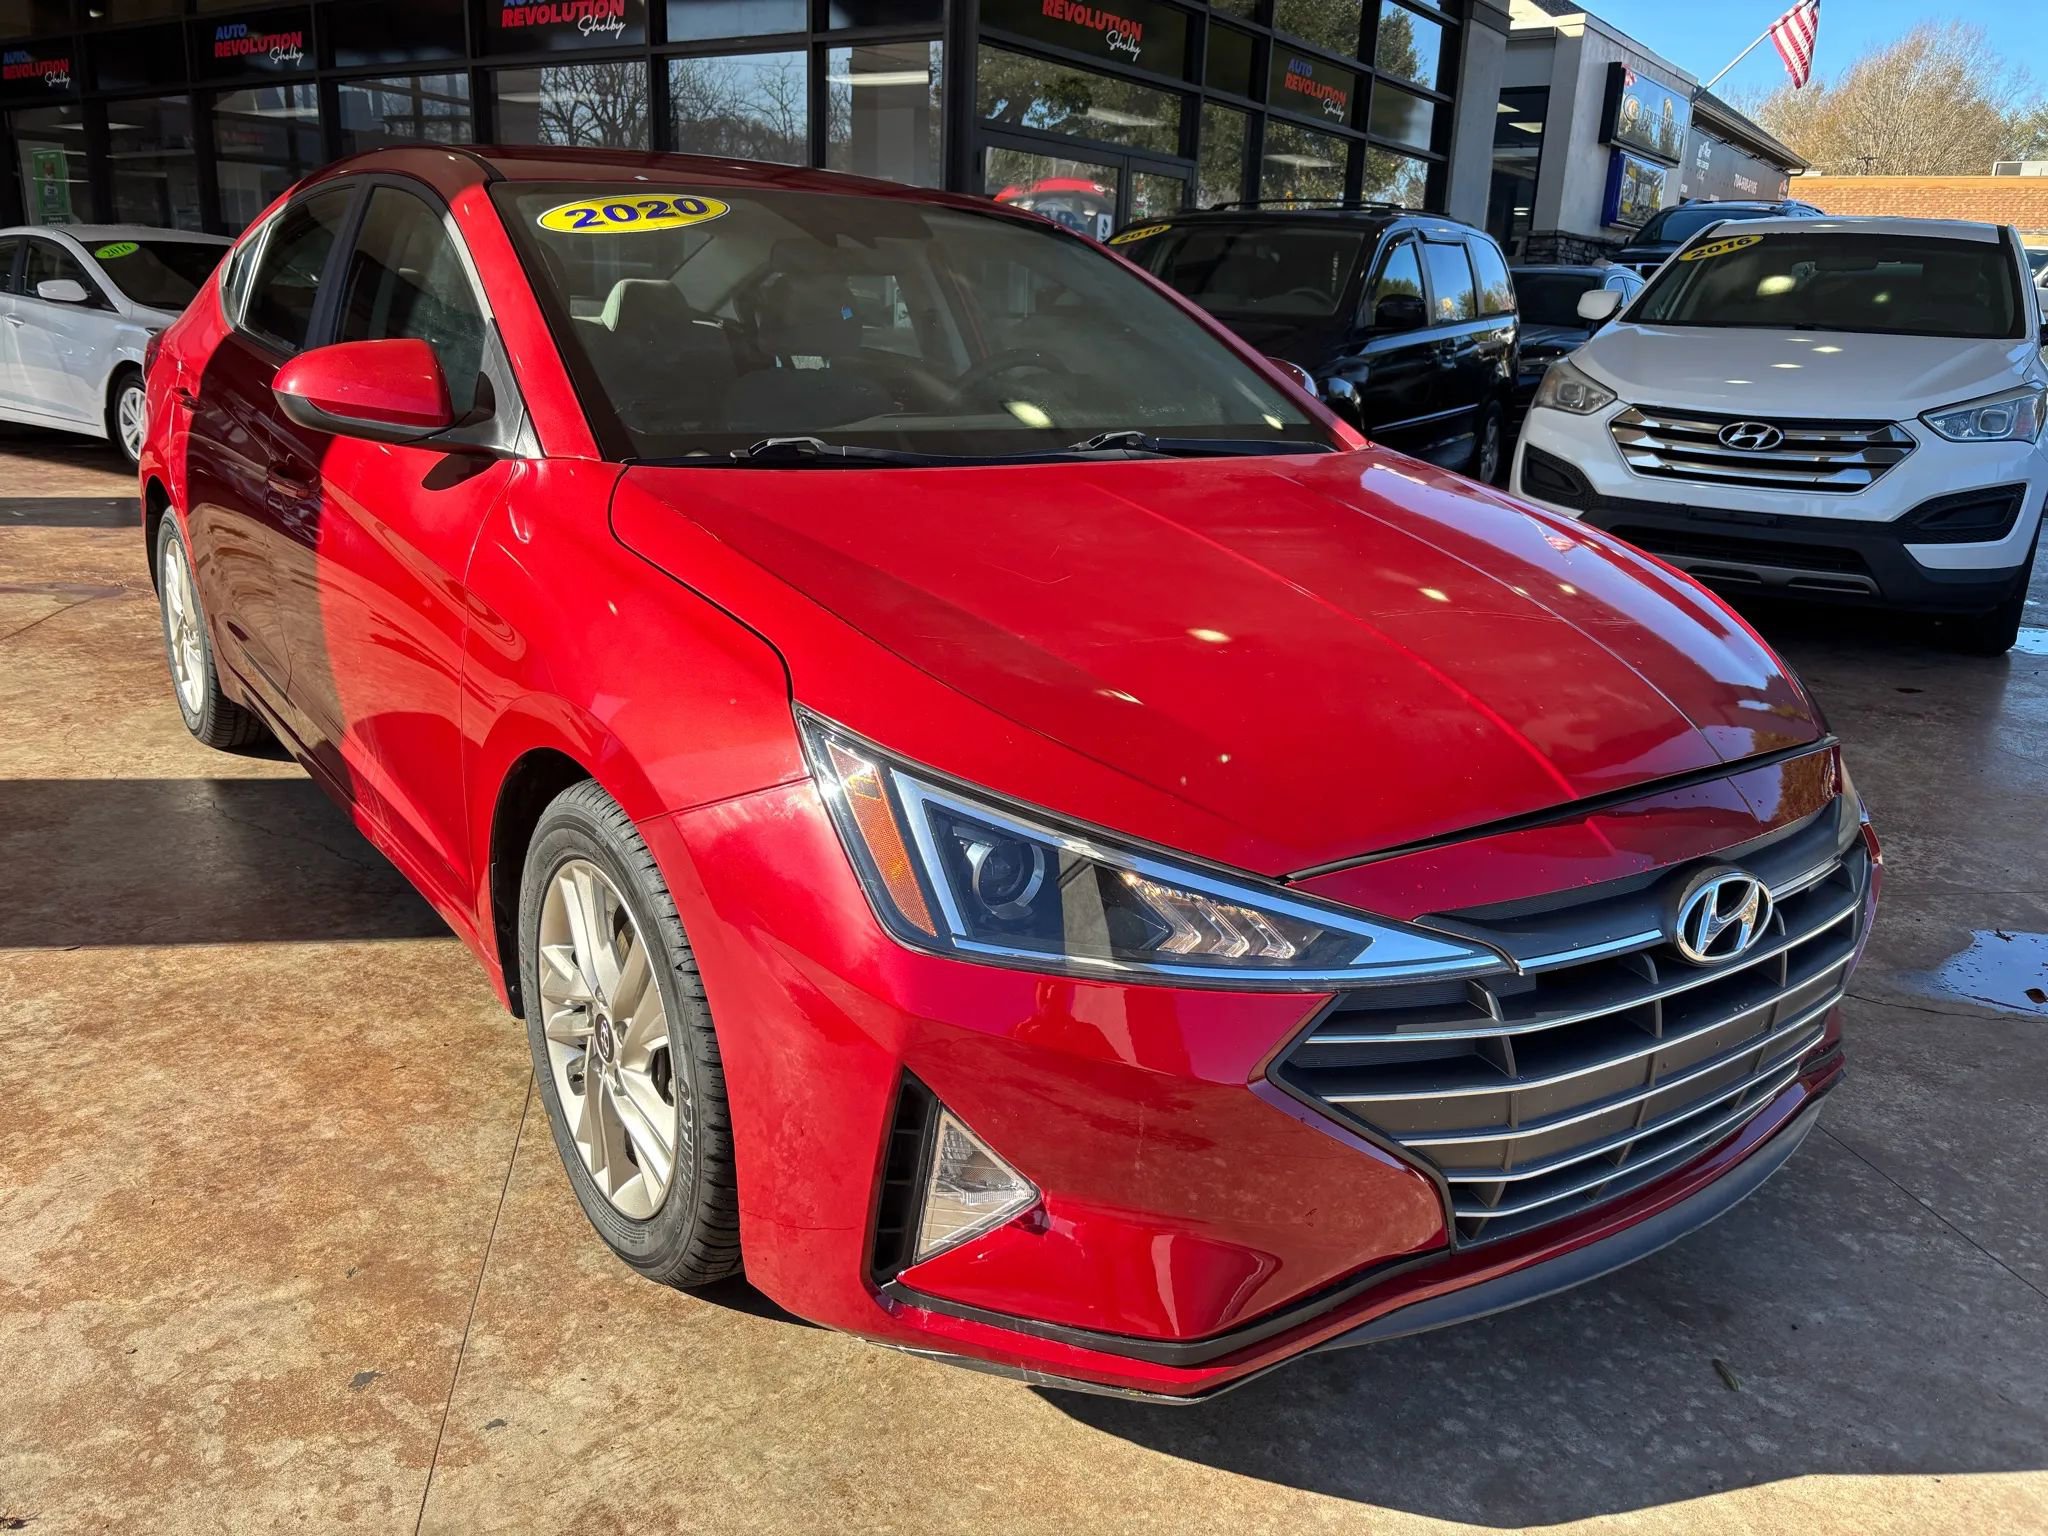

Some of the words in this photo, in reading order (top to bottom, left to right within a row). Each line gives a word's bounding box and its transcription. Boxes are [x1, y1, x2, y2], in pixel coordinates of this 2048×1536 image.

[502, 0, 624, 27] REVOLUTION
[1042, 0, 1142, 41] REVOLUTION
[215, 24, 247, 40] AUTO
[577, 11, 626, 40] Shelby
[214, 32, 302, 57] REVOLUTION
[269, 44, 304, 66] Shelby
[1105, 30, 1141, 62] Shelby
[3, 59, 68, 79] REVOLUTION
[44, 69, 70, 88] Shelby
[1288, 58, 1312, 78] AUTO
[1284, 71, 1346, 106] REVOLUTION
[1322, 98, 1344, 123] Shelby
[564, 198, 710, 229] 2020
[1119, 226, 1163, 241] 2010
[104, 243, 132, 257] 2016
[1690, 237, 1752, 258] 2016
